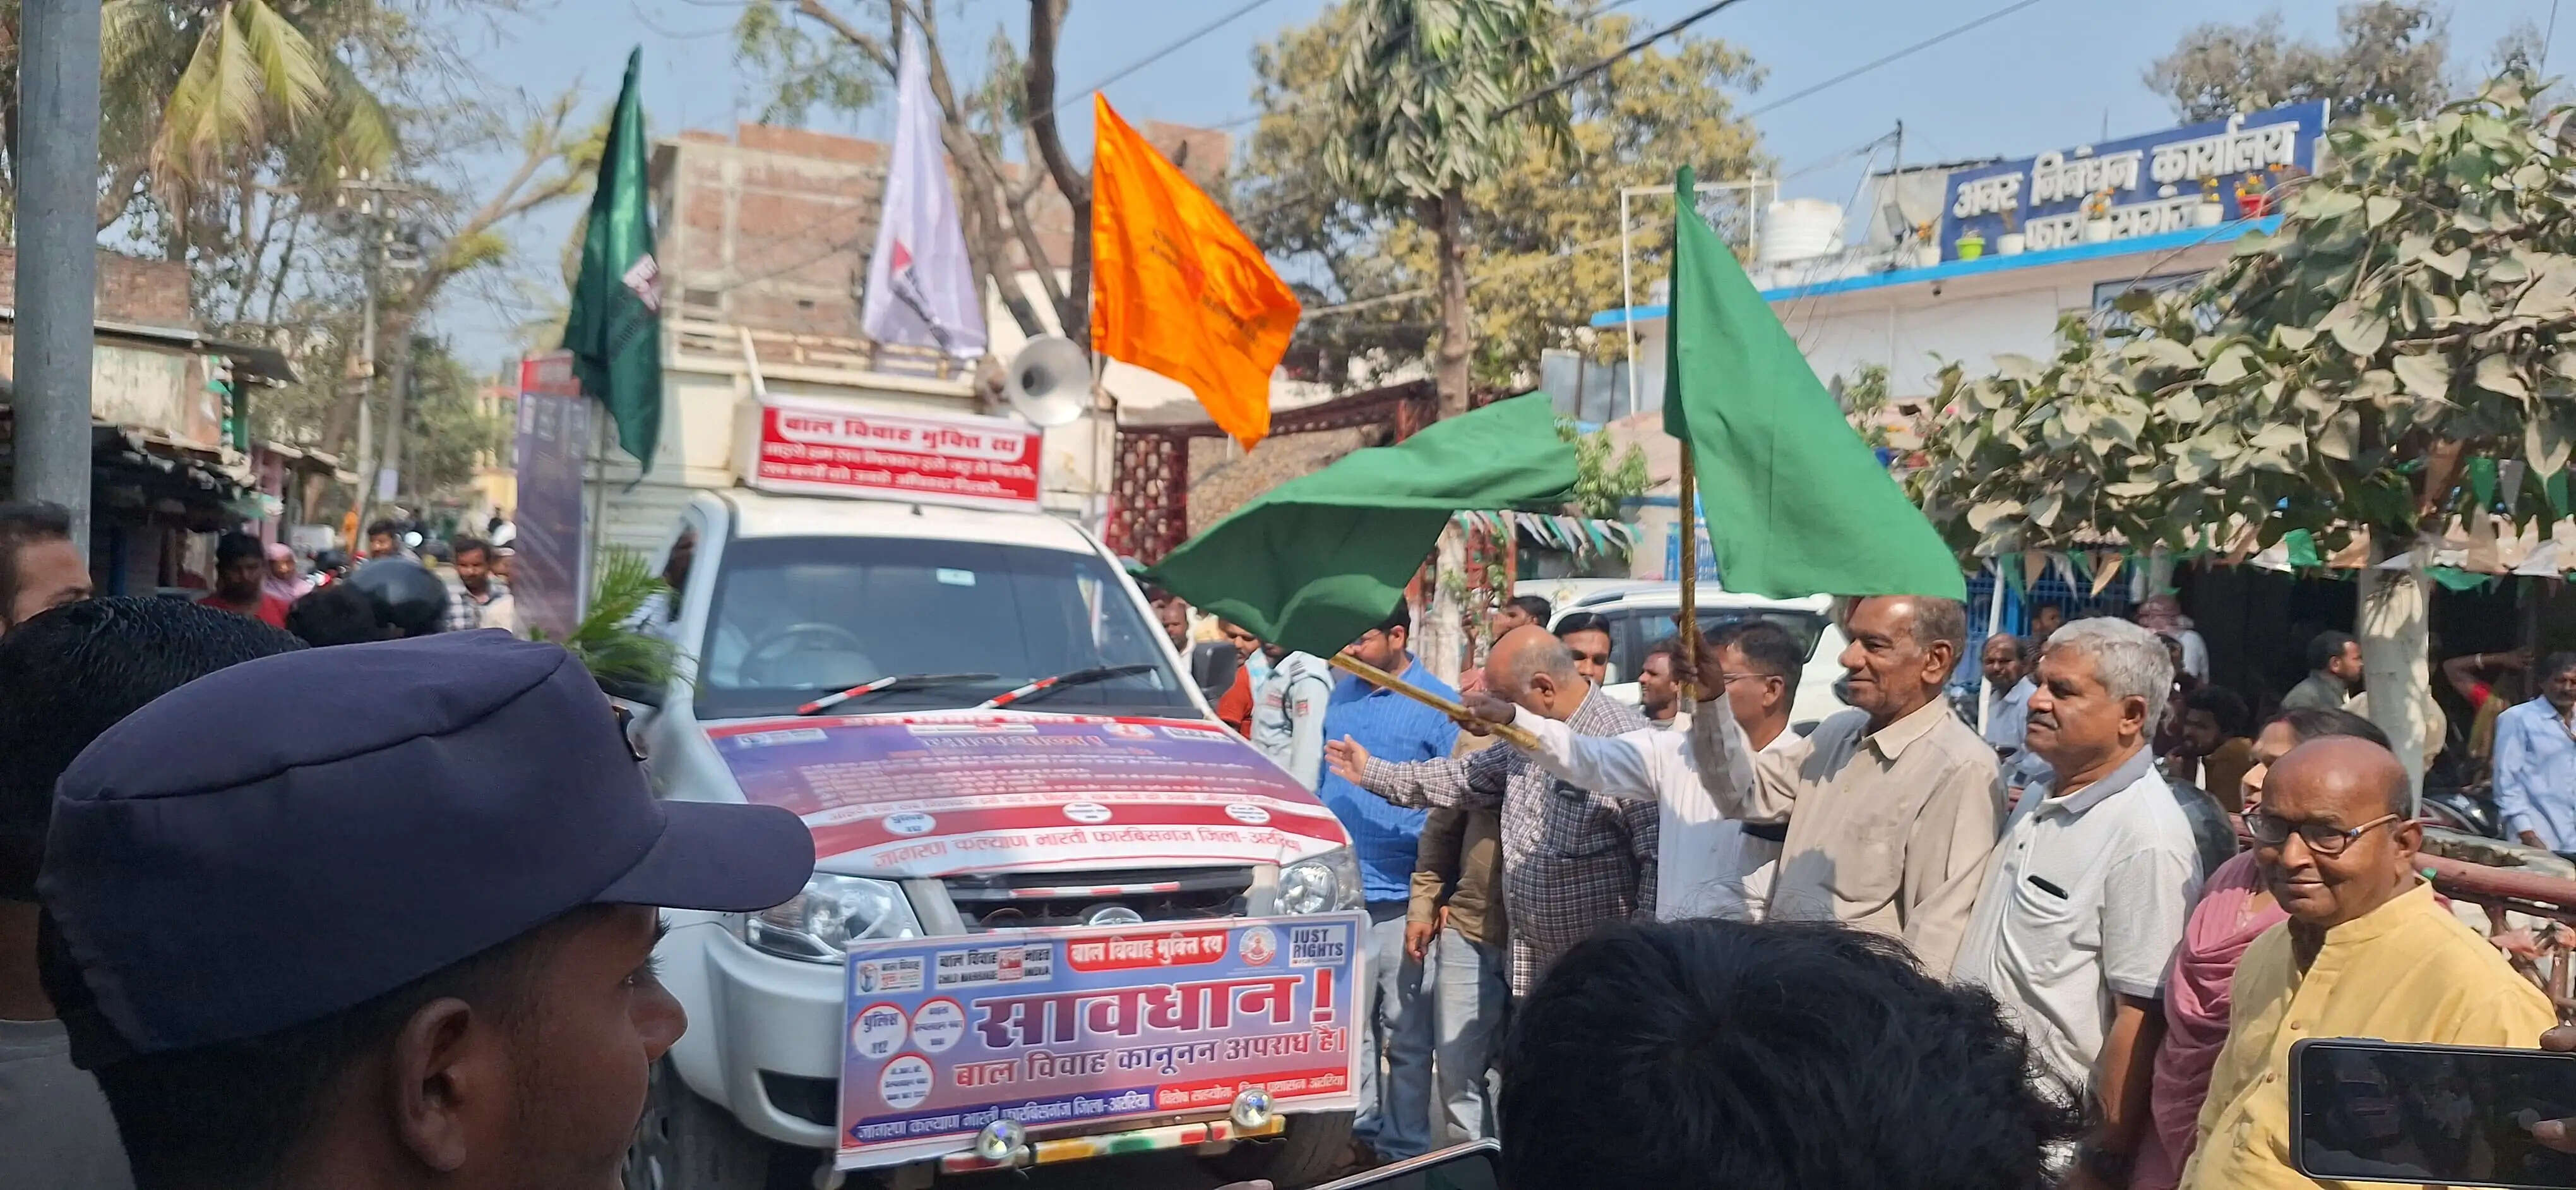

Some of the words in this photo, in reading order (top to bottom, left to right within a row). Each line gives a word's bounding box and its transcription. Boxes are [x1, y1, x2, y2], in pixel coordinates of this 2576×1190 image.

[1953, 171, 2023, 219] अवर
[2030, 144, 2144, 207] निबंधन
[2152, 113, 2300, 184] कार्यालय
[785, 418, 833, 434] बाल
[871, 841, 947, 868] जागरण
[952, 834, 1029, 851] कल्याण
[1034, 828, 1087, 846] भारती
[1071, 943, 1106, 963] बाल
[1108, 935, 1154, 960] विवाह
[1157, 932, 1199, 965] मुक्ति
[1201, 935, 1224, 954] रथ
[1293, 929, 1328, 944] JUST
[1293, 942, 1344, 958] RIGHTS
[862, 1011, 900, 1033] पुलिस
[953, 1060, 1019, 1088] बाल
[1027, 1050, 1112, 1080] विवाह
[1116, 1038, 1220, 1076] कानूनन
[1225, 1031, 1311, 1062] अपराध
[856, 1121, 907, 1139] जागरण
[909, 1114, 960, 1133] कल्याण
